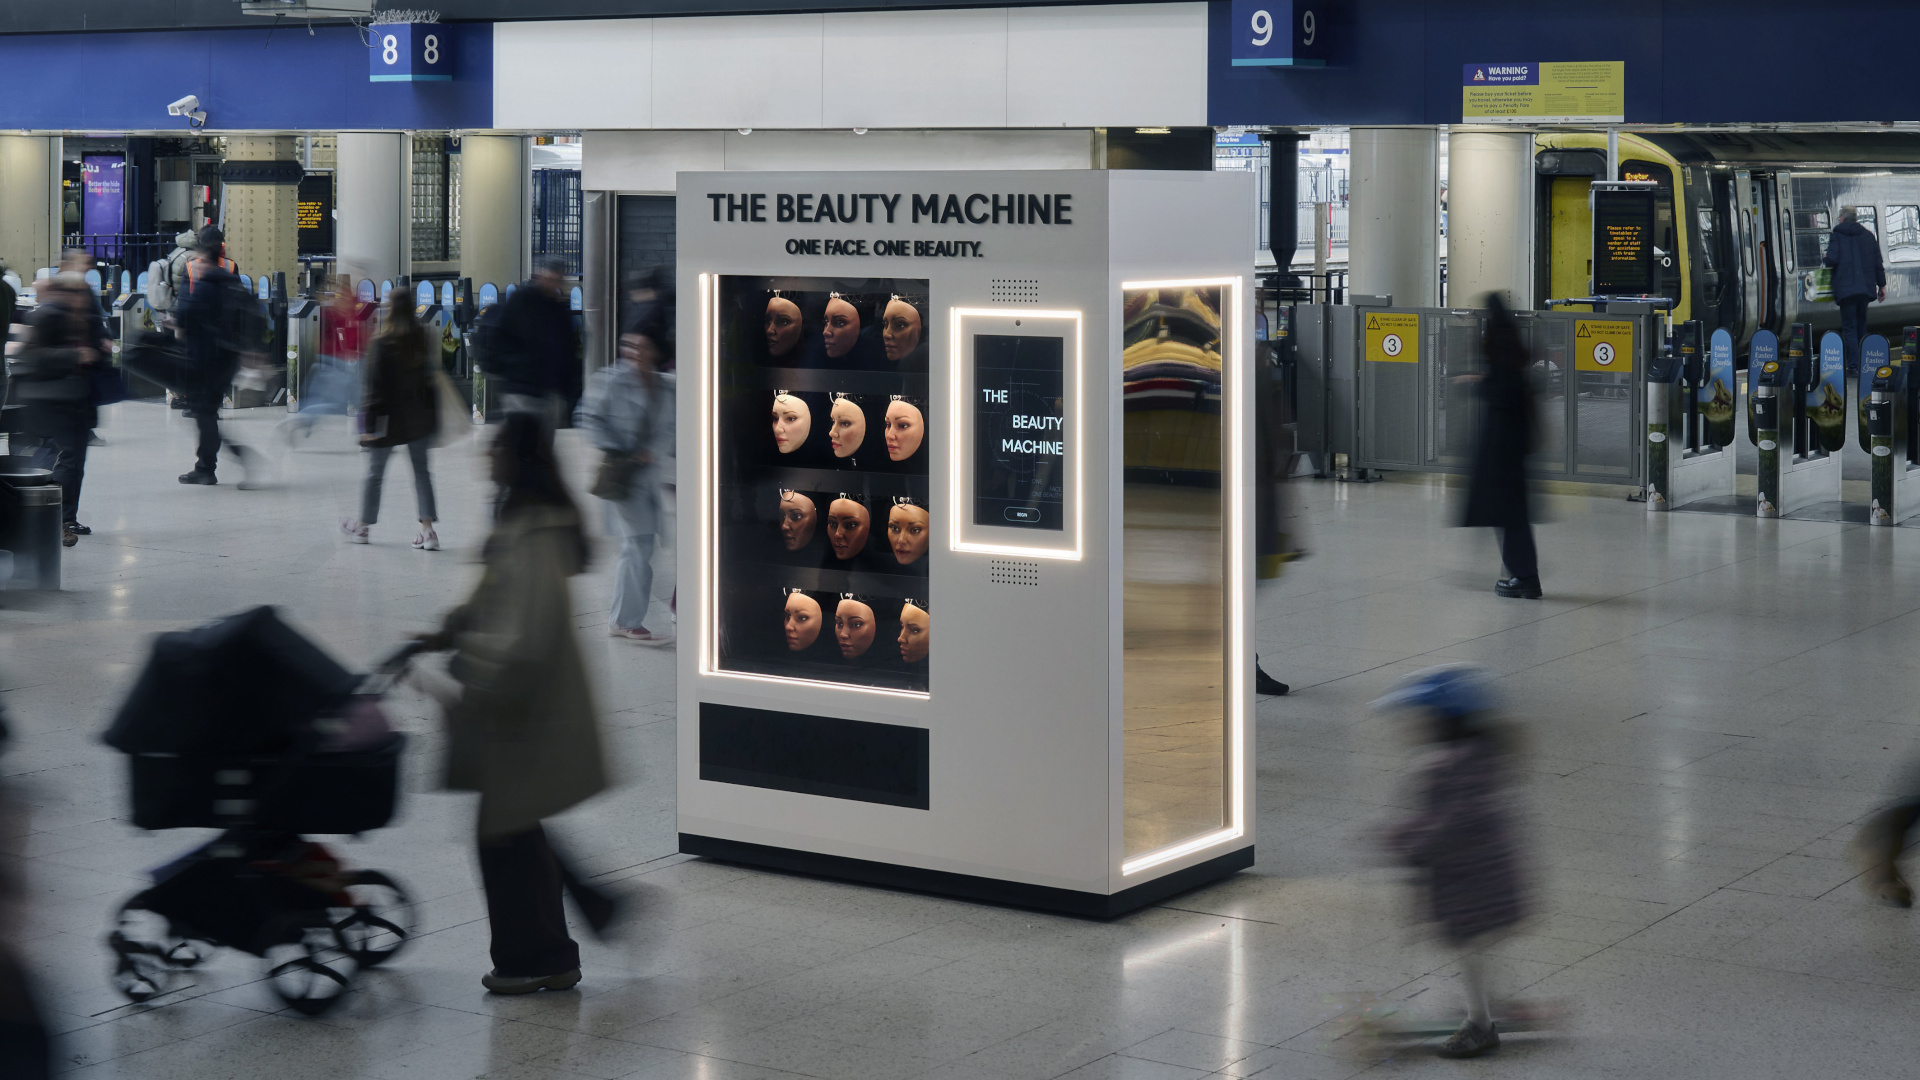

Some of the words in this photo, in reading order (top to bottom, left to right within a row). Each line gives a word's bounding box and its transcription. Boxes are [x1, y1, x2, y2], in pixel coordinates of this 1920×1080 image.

[1251, 10, 1273, 46] 9
[1303, 10, 1316, 46] 9
[383, 34, 398, 65] 8
[424, 34, 439, 64] 8
[1488, 66, 1528, 75] WARNING
[707, 193, 767, 222] THE
[776, 193, 902, 224] BEAUTY
[911, 193, 1072, 225] MACHINE
[785, 238, 820, 256] ONE
[824, 239, 869, 256] FACE.
[873, 239, 910, 256] ONE
[913, 240, 983, 258] BEAUTY.
[1388, 338, 1397, 352] 3
[1600, 347, 1609, 361] 3
[983, 389, 1008, 403] THE
[1012, 414, 1063, 430] BEAUTY
[1002, 439, 1063, 455] MACHINE
